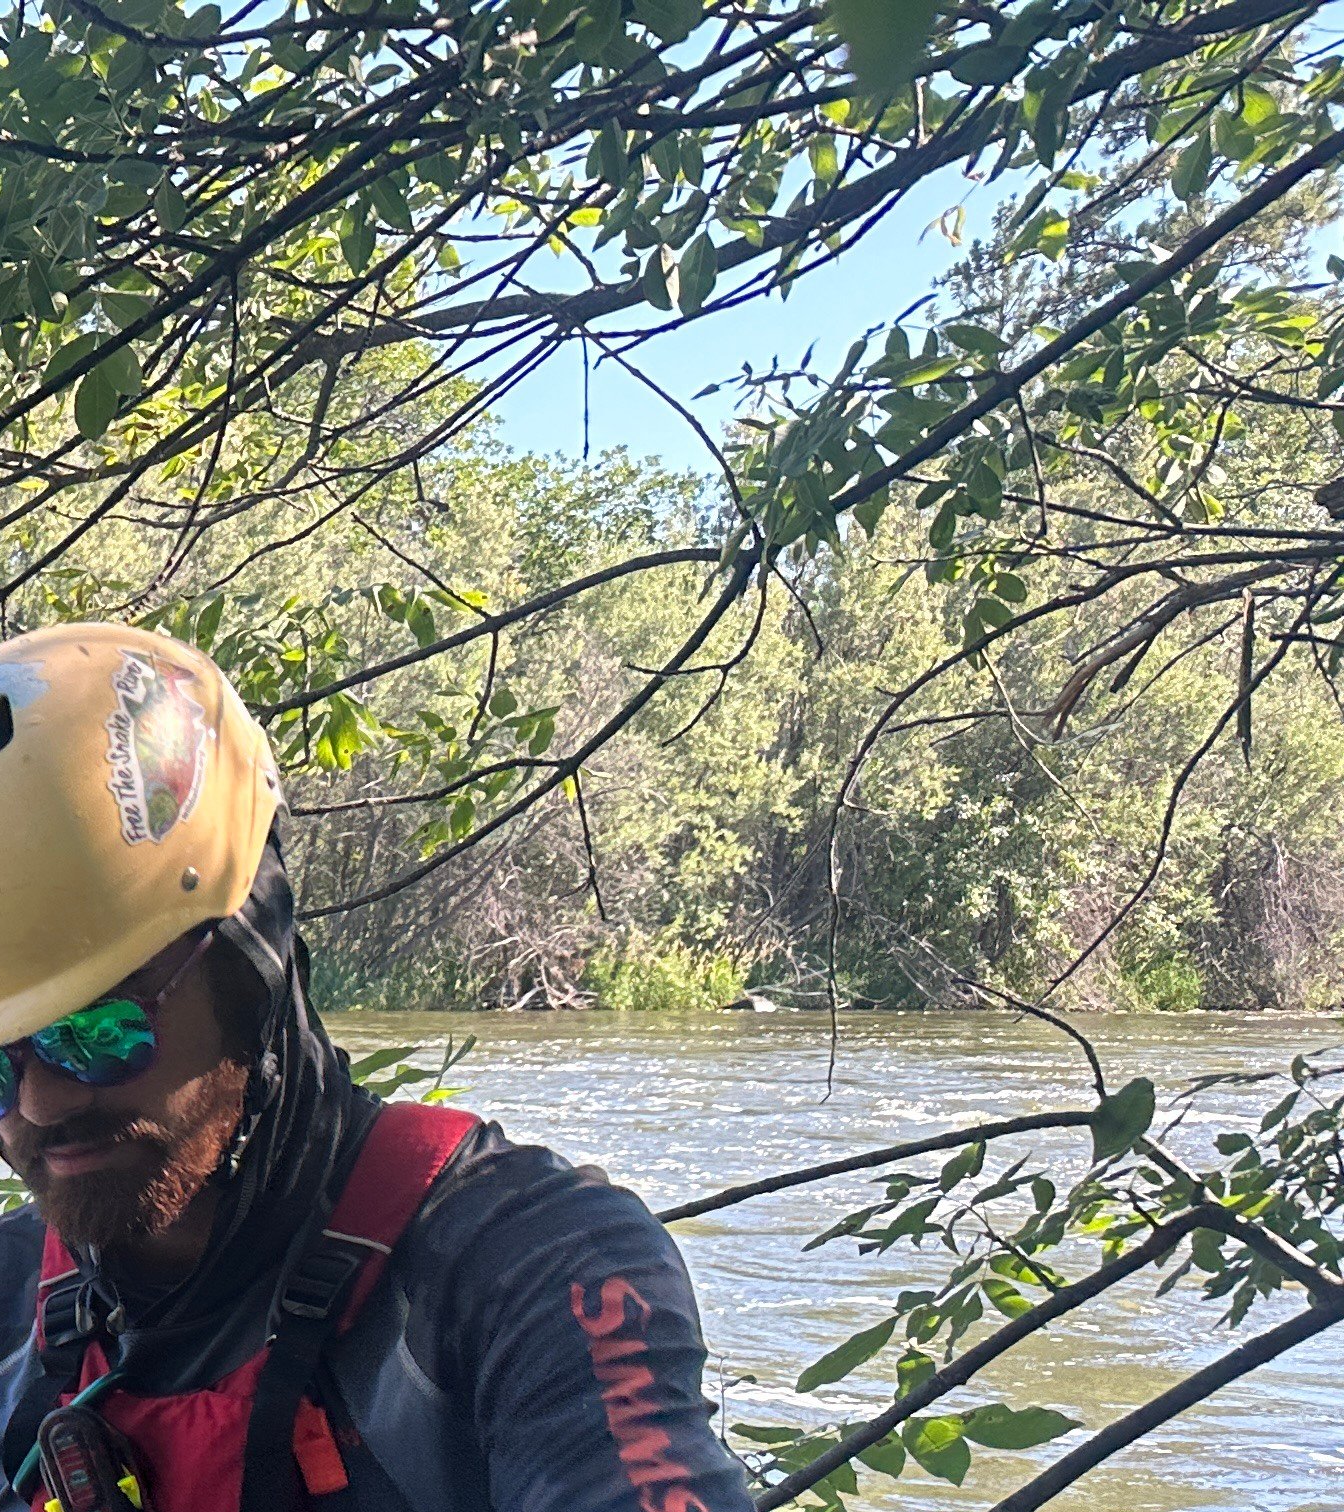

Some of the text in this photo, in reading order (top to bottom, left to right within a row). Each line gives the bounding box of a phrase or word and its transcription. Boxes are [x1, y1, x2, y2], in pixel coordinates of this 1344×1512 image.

[109, 713, 132, 764] Snake
[113, 767, 138, 800] The
[125, 804, 148, 841] Free
